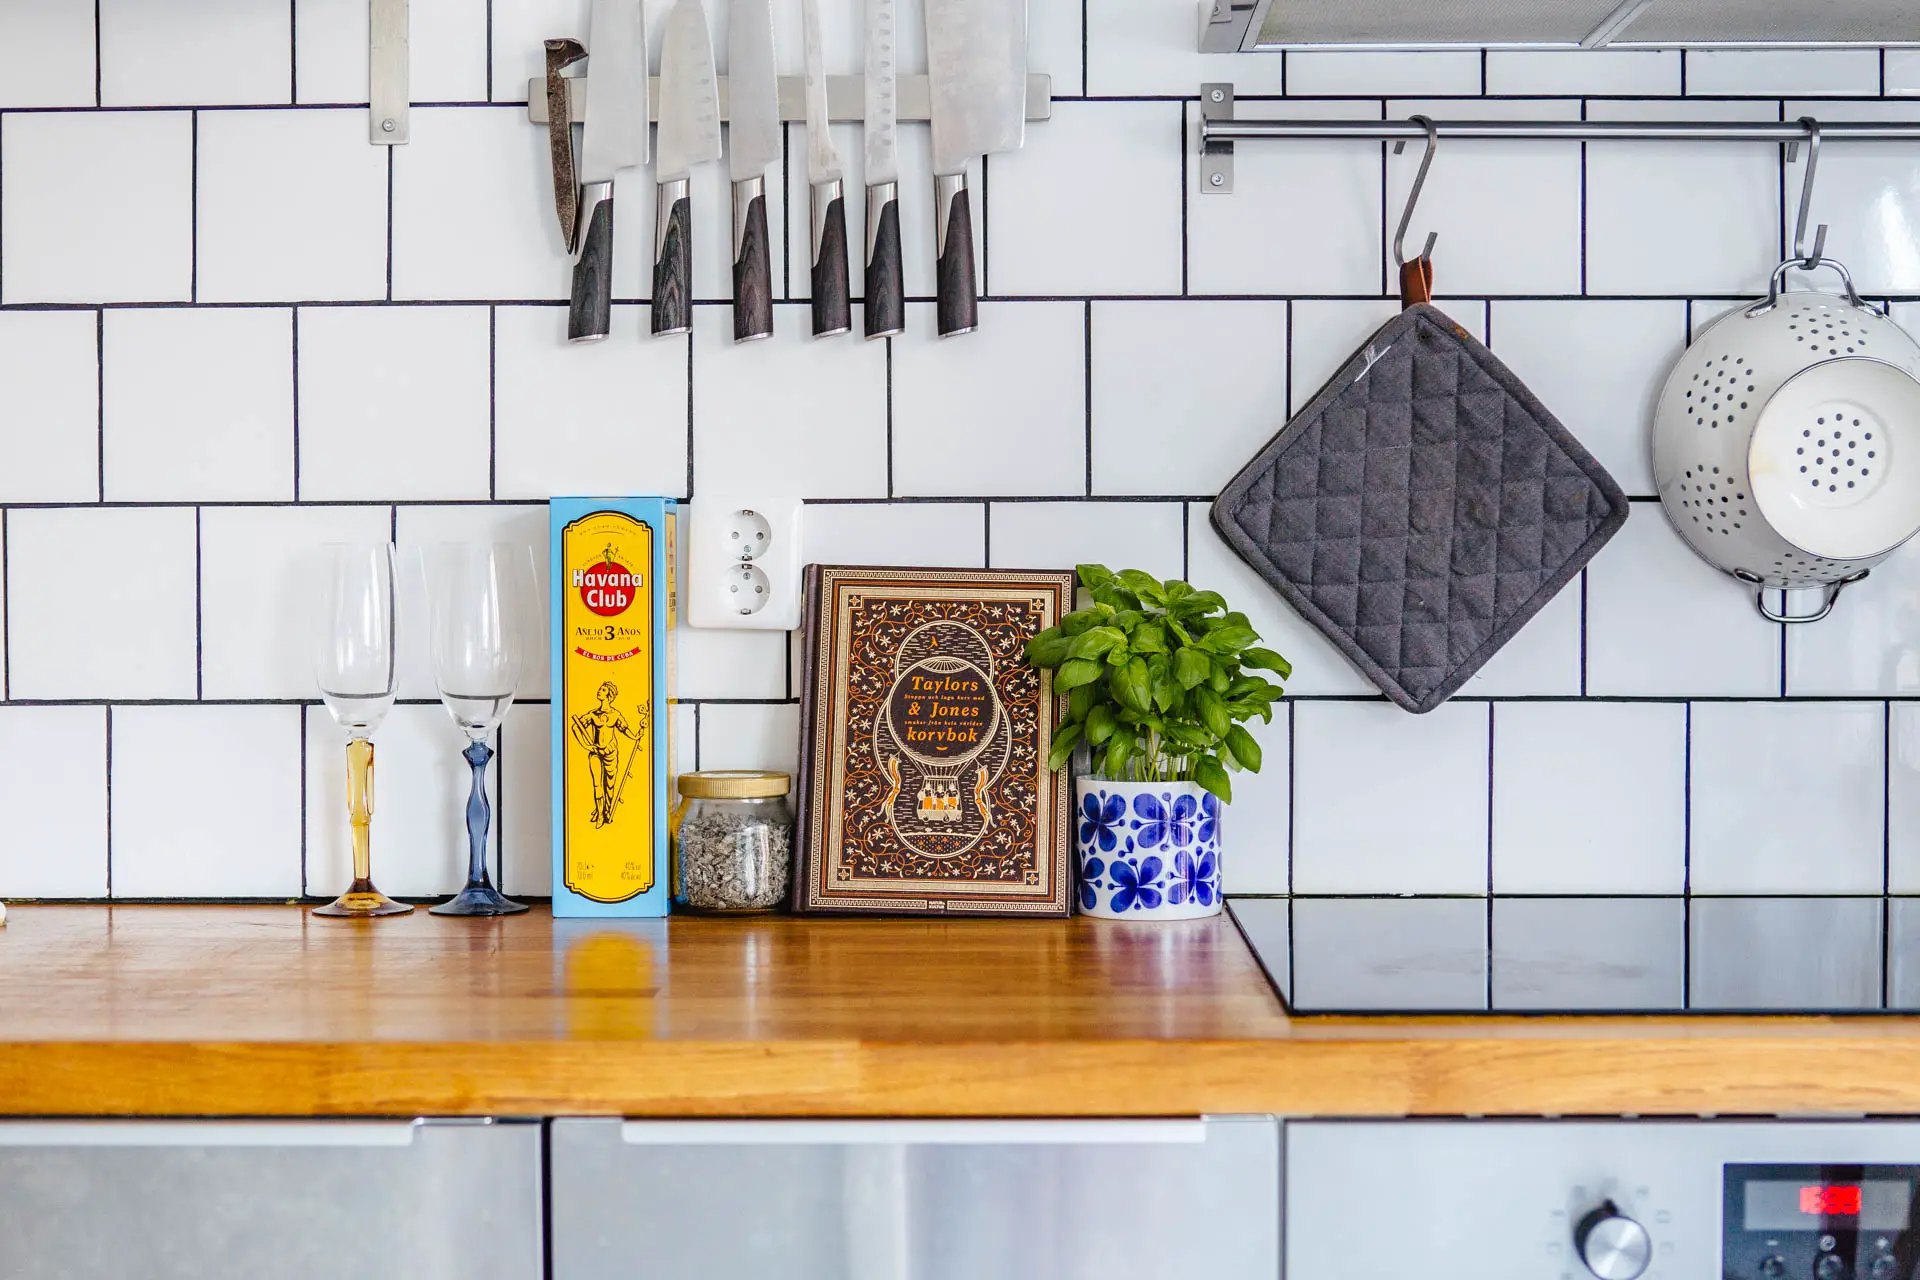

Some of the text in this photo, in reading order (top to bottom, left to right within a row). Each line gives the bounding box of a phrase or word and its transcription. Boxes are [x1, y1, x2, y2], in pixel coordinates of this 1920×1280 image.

[572, 569, 643, 587] Havana
[587, 589, 627, 608] Club
[604, 625, 615, 640] 3
[911, 676, 979, 694] Taylors
[908, 701, 980, 719] & Jones
[906, 726, 979, 742] korvbok
